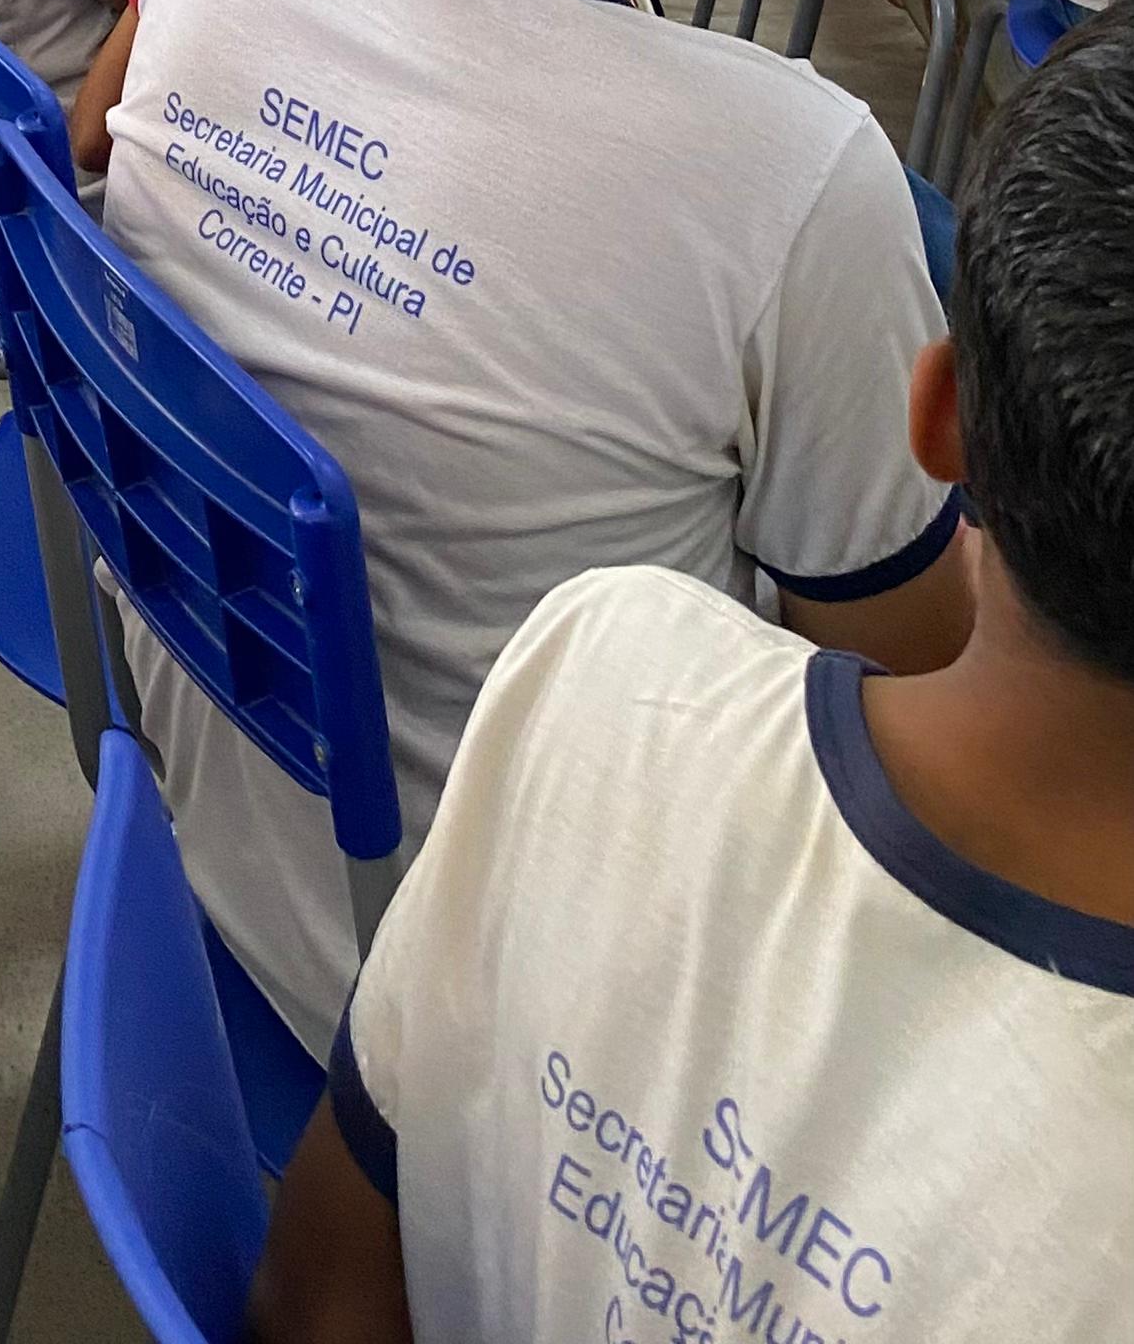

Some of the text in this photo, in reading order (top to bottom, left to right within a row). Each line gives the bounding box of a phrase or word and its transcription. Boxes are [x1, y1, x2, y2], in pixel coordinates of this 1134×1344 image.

[163, 92, 476, 286] Secretaria Municipal de
[259, 87, 389, 181] SEMEC
[165, 142, 427, 318] Educação e Cultura
[198, 209, 307, 299] Corrente
[327, 291, 363, 335] PI
